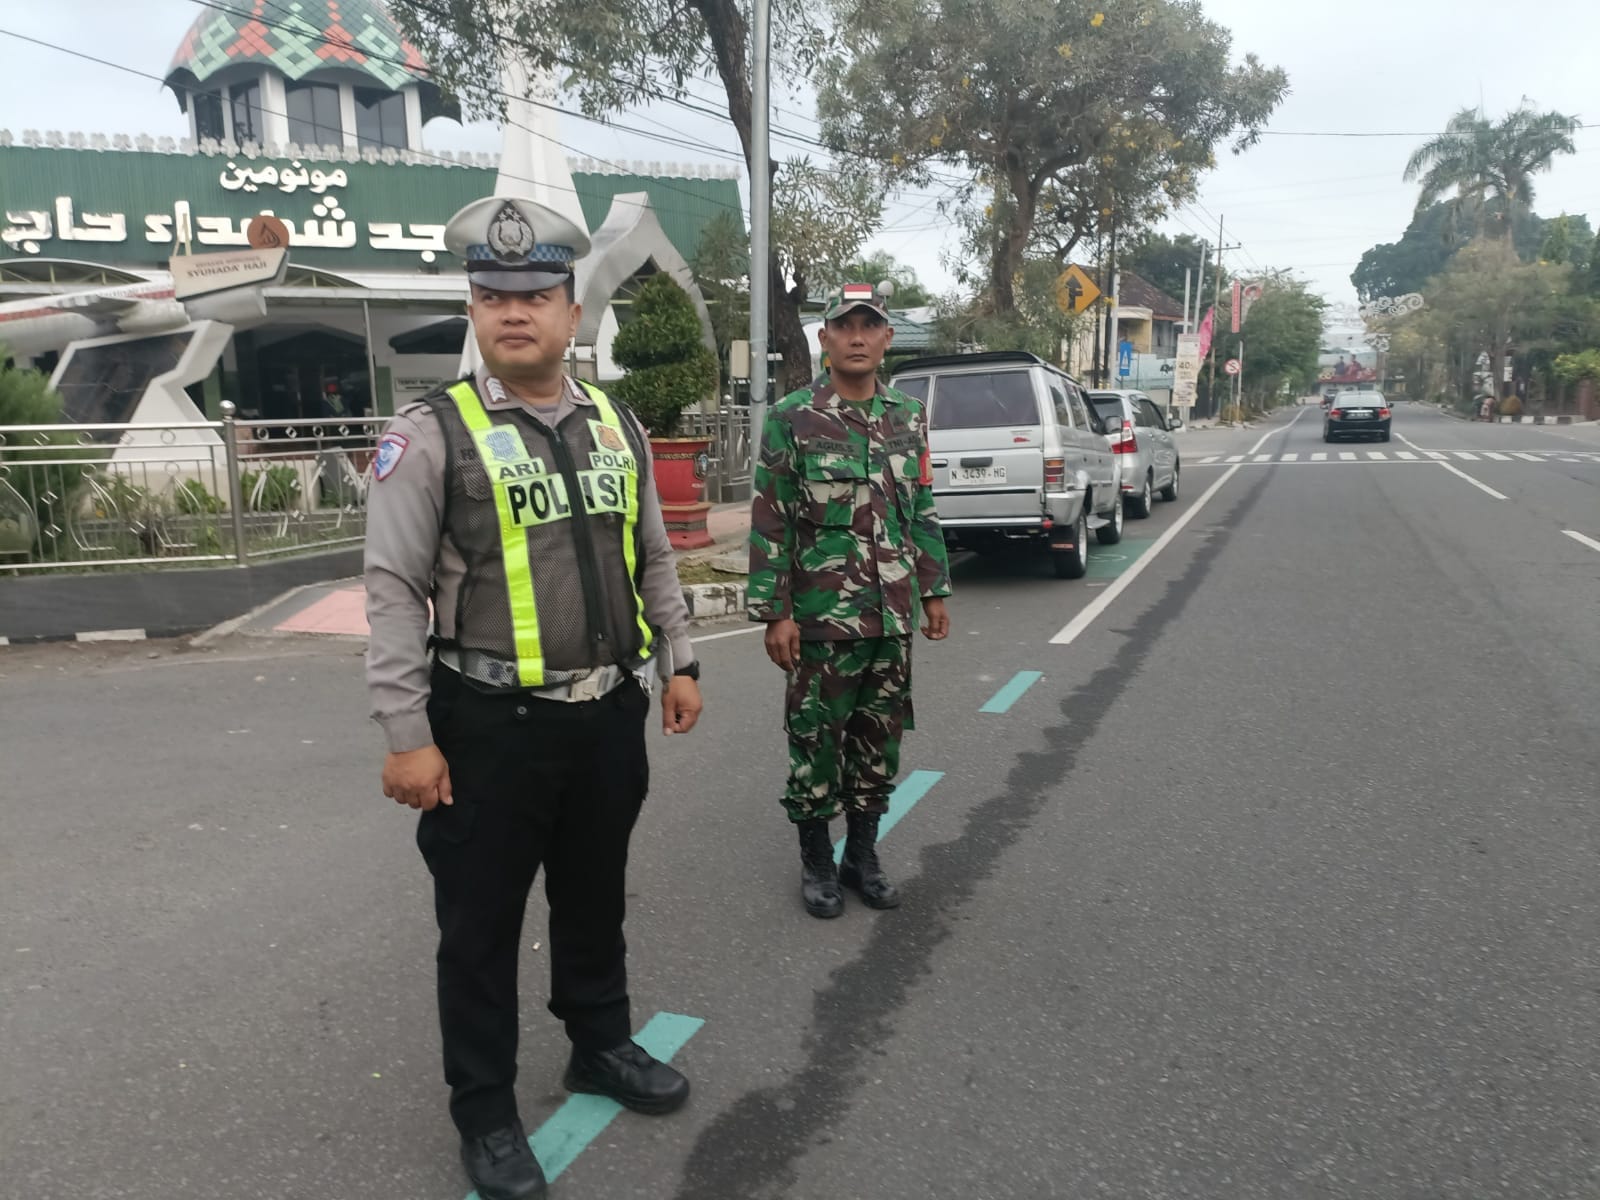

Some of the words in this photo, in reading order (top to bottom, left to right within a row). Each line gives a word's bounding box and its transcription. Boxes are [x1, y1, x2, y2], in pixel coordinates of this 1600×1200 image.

[367, 221, 449, 263] جد
[500, 461, 541, 480] ARI
[592, 454, 635, 471] POLRI
[951, 470, 958, 480] N
